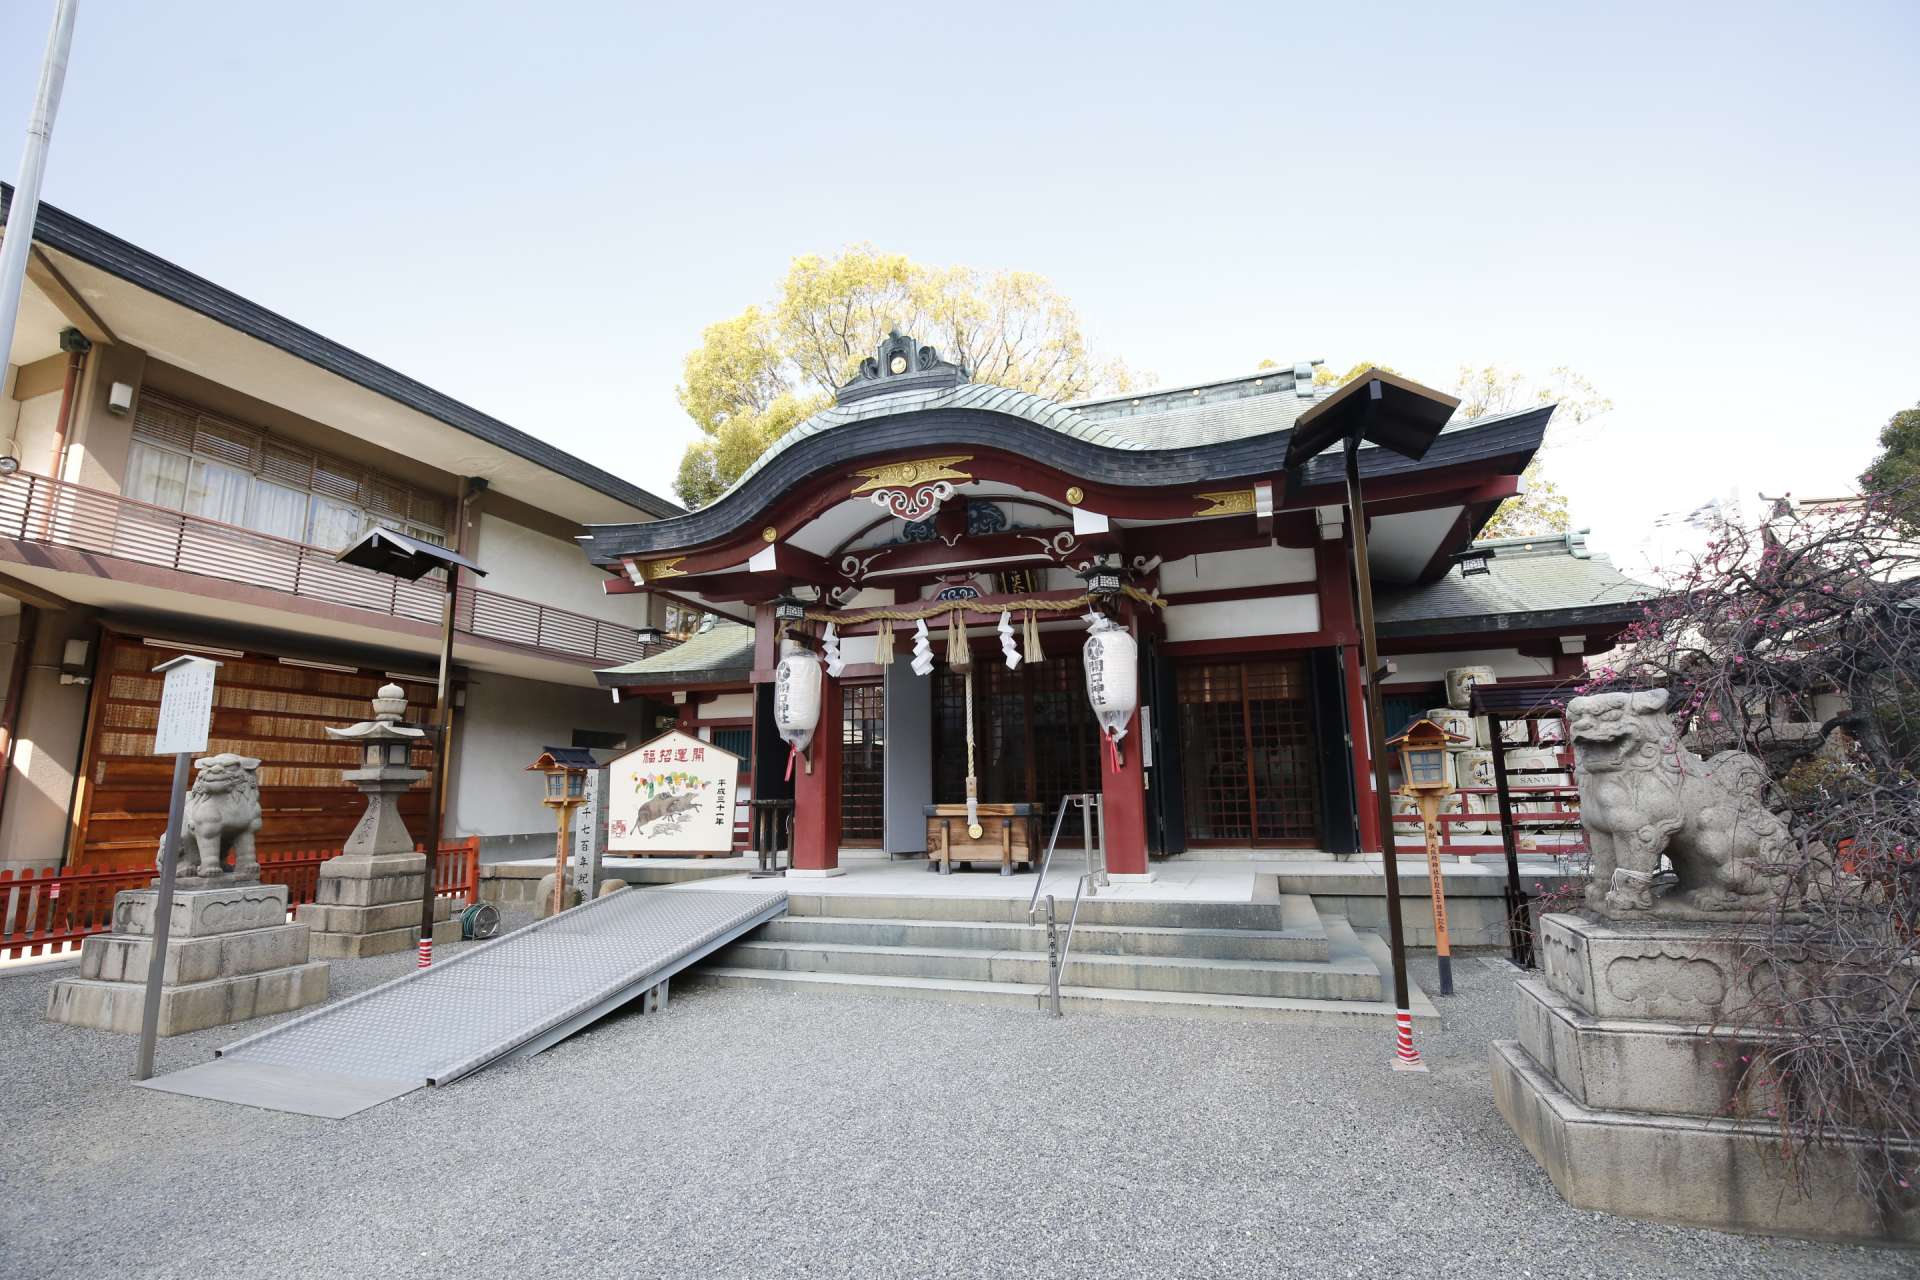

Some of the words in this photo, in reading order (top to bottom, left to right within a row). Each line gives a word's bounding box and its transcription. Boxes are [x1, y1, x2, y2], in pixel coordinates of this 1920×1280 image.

[714, 778, 727, 826] 平成三十一年
